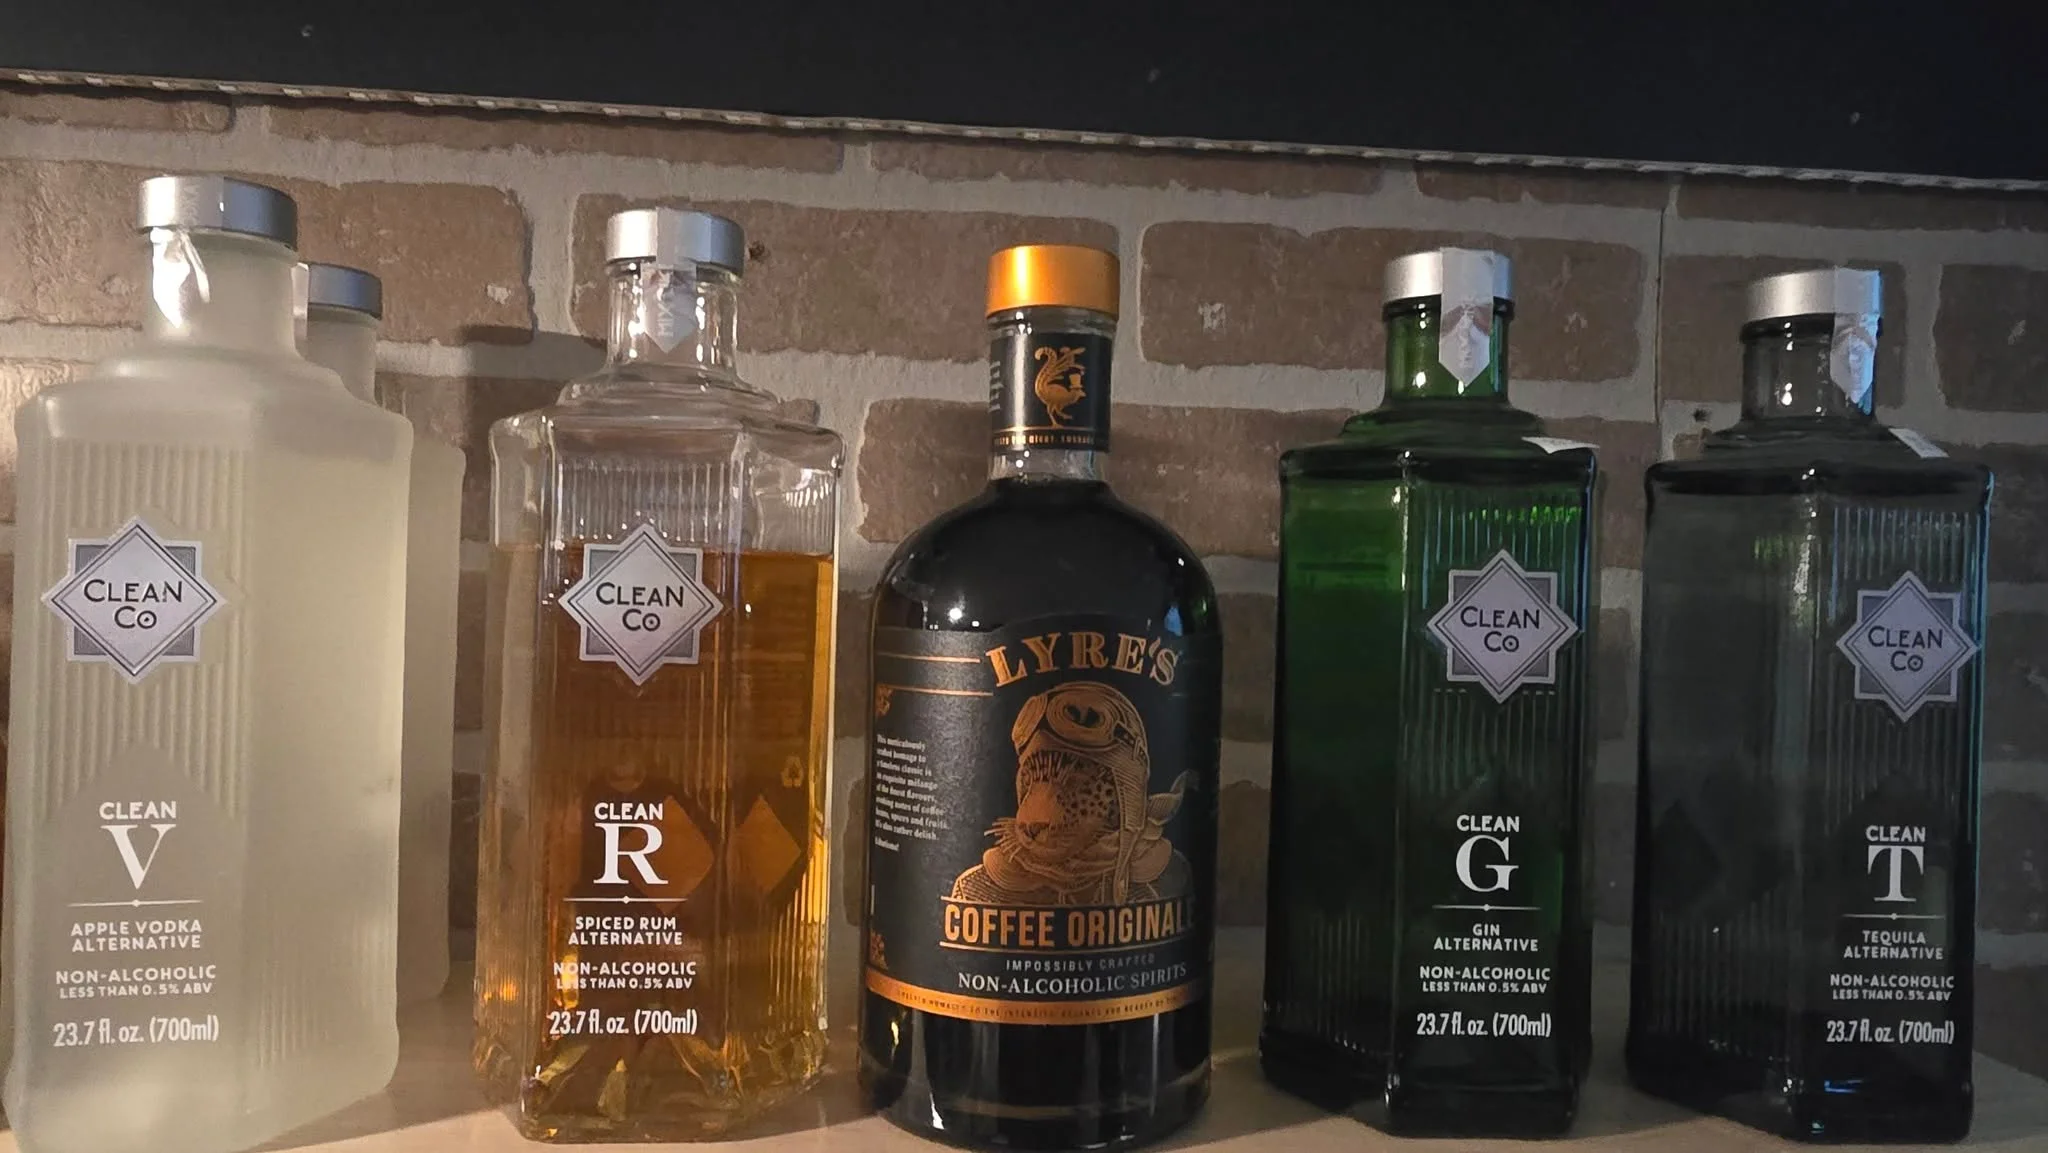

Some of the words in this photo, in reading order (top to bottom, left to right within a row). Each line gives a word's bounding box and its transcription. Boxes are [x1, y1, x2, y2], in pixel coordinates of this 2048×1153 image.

[84, 578, 182, 604] CLEAN
[596, 582, 684, 608] CLEAN
[1460, 606, 1540, 630] CLEAN
[1868, 626, 1943, 648] CLEAN
[985, 630, 1180, 687] LYRE'S
[99, 800, 177, 820] CLEAN
[594, 802, 664, 821] CLEAN
[1456, 814, 1520, 832] CLEAN
[1866, 825, 1926, 842] CLEAN
[100, 823, 177, 890] V
[592, 822, 669, 885] R
[1456, 834, 1520, 892] G
[1868, 845, 1924, 902] T
[70, 921, 130, 937] APPLE
[135, 919, 202, 935] VODKA
[575, 916, 635, 930] SPICED
[640, 916, 677, 930] RUM
[944, 903, 1055, 947] COFFEE
[1472, 924, 1500, 937] GIN
[72, 934, 202, 952] ALTERNATIVE
[568, 932, 683, 946] ALTERNATIVE
[1434, 937, 1538, 952] ALTERNATIVE
[1862, 930, 1926, 946] TEQUILA
[1006, 958, 1093, 973] IMPOSSIBLY
[1099, 952, 1156, 970] CRAFTED
[1843, 946, 1944, 960] ALTERNATIVE
[55, 964, 216, 985] NON-ALCOHOLIC
[553, 961, 697, 976] NON-ALCOHOLIC
[1419, 966, 1551, 981] NON-ALCOHOLIC
[590, 978, 626, 990] THAN
[628, 978, 663, 990] 0.5%
[666, 978, 692, 990] ABV
[958, 972, 1125, 995] NON-ALCOHOLIC
[1130, 962, 1187, 989] SPIRITS
[1422, 982, 1450, 992] LESS
[1453, 982, 1486, 993] THAN
[1488, 982, 1519, 993] 0.5%
[1522, 983, 1547, 994] ABV
[1830, 974, 1955, 988] NON-ALCOHOLIC
[59, 986, 95, 1000] LESS
[98, 985, 139, 998] THAN
[142, 983, 180, 996] 0.5%
[183, 982, 213, 994] ABV
[1832, 988, 1859, 1000] LESS
[1862, 990, 1892, 1000] THAN
[1895, 990, 1925, 1000] 0.5%
[1928, 991, 1952, 1002] ABV
[52, 1020, 96, 1048] 23.7
[98, 1018, 116, 1044] fl.
[118, 1025, 144, 1044] oz.
[149, 1014, 220, 1044] (700ml)
[550, 1011, 588, 1035] 23.7
[588, 1008, 604, 1035] fl.
[606, 1016, 629, 1035] oz.
[634, 1008, 698, 1036] (700ml)
[1416, 1012, 1450, 1036] 23.7
[1452, 1011, 1466, 1036] fl.
[1467, 1019, 1488, 1036] oz.
[1492, 1012, 1552, 1038] (700ml)
[1826, 1020, 1858, 1042] 23.7
[1860, 1018, 1872, 1042] fl.
[1874, 1026, 1894, 1042] oz.
[1900, 1020, 1955, 1044] (700ml)
